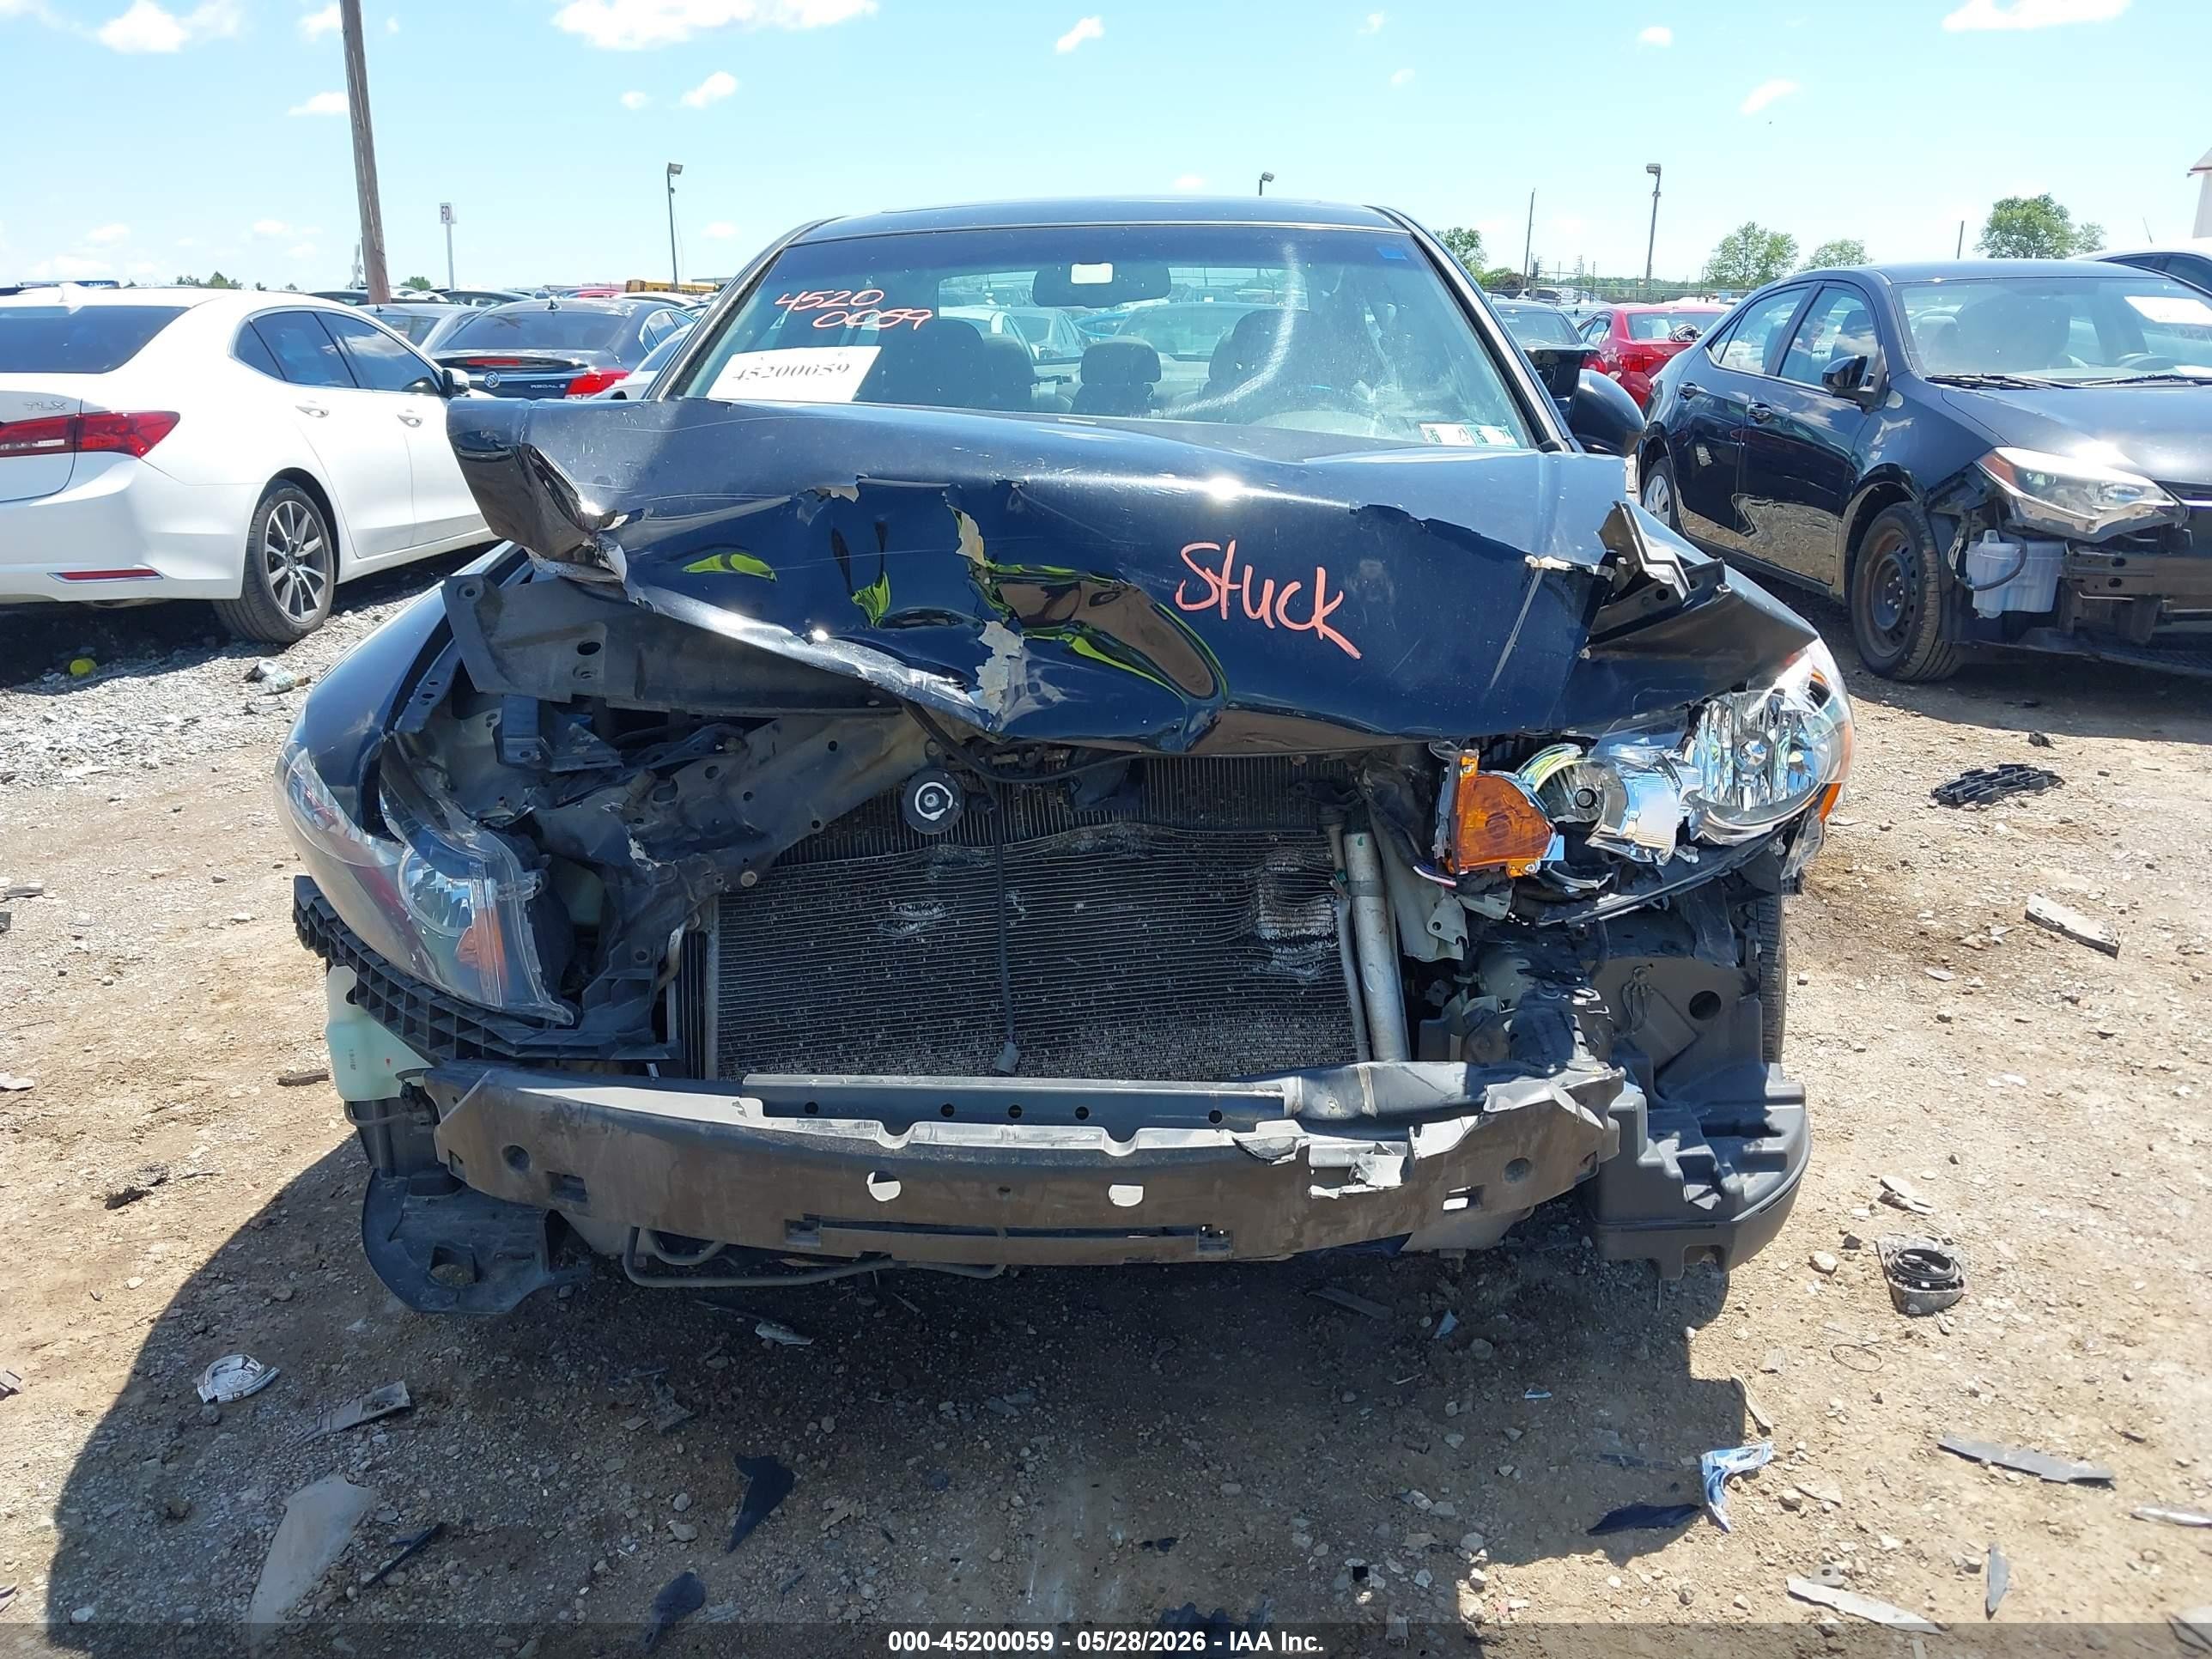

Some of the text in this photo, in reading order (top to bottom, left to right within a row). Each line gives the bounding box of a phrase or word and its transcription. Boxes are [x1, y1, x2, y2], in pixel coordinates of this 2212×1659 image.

[775, 289, 884, 311] 4520
[812, 308, 933, 331] 0059
[23, 400, 67, 411] TLX
[1175, 539, 1363, 659] Stuck
